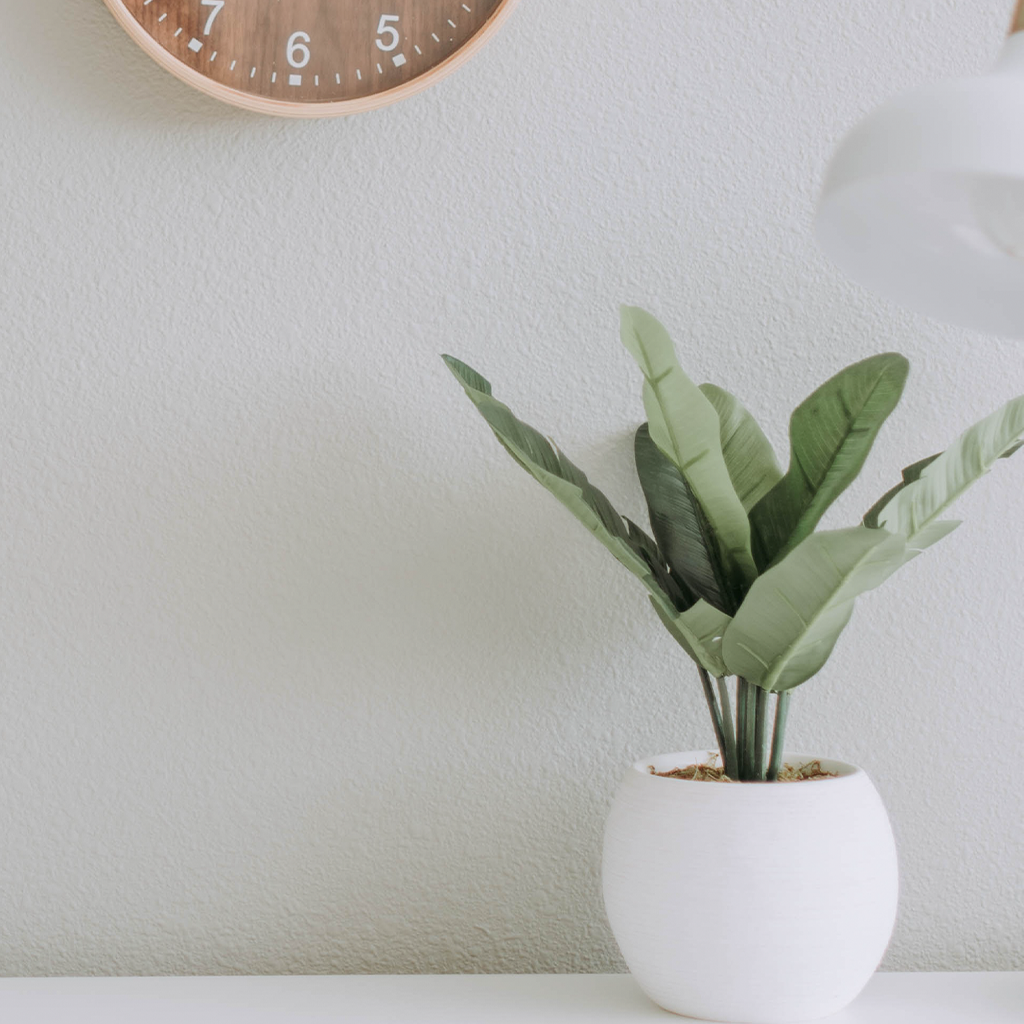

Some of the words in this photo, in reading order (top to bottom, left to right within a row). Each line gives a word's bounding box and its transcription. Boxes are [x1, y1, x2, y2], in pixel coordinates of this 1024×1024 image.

[201, 0, 224, 35] 7
[375, 15, 400, 51] 5
[286, 31, 311, 68] 6
